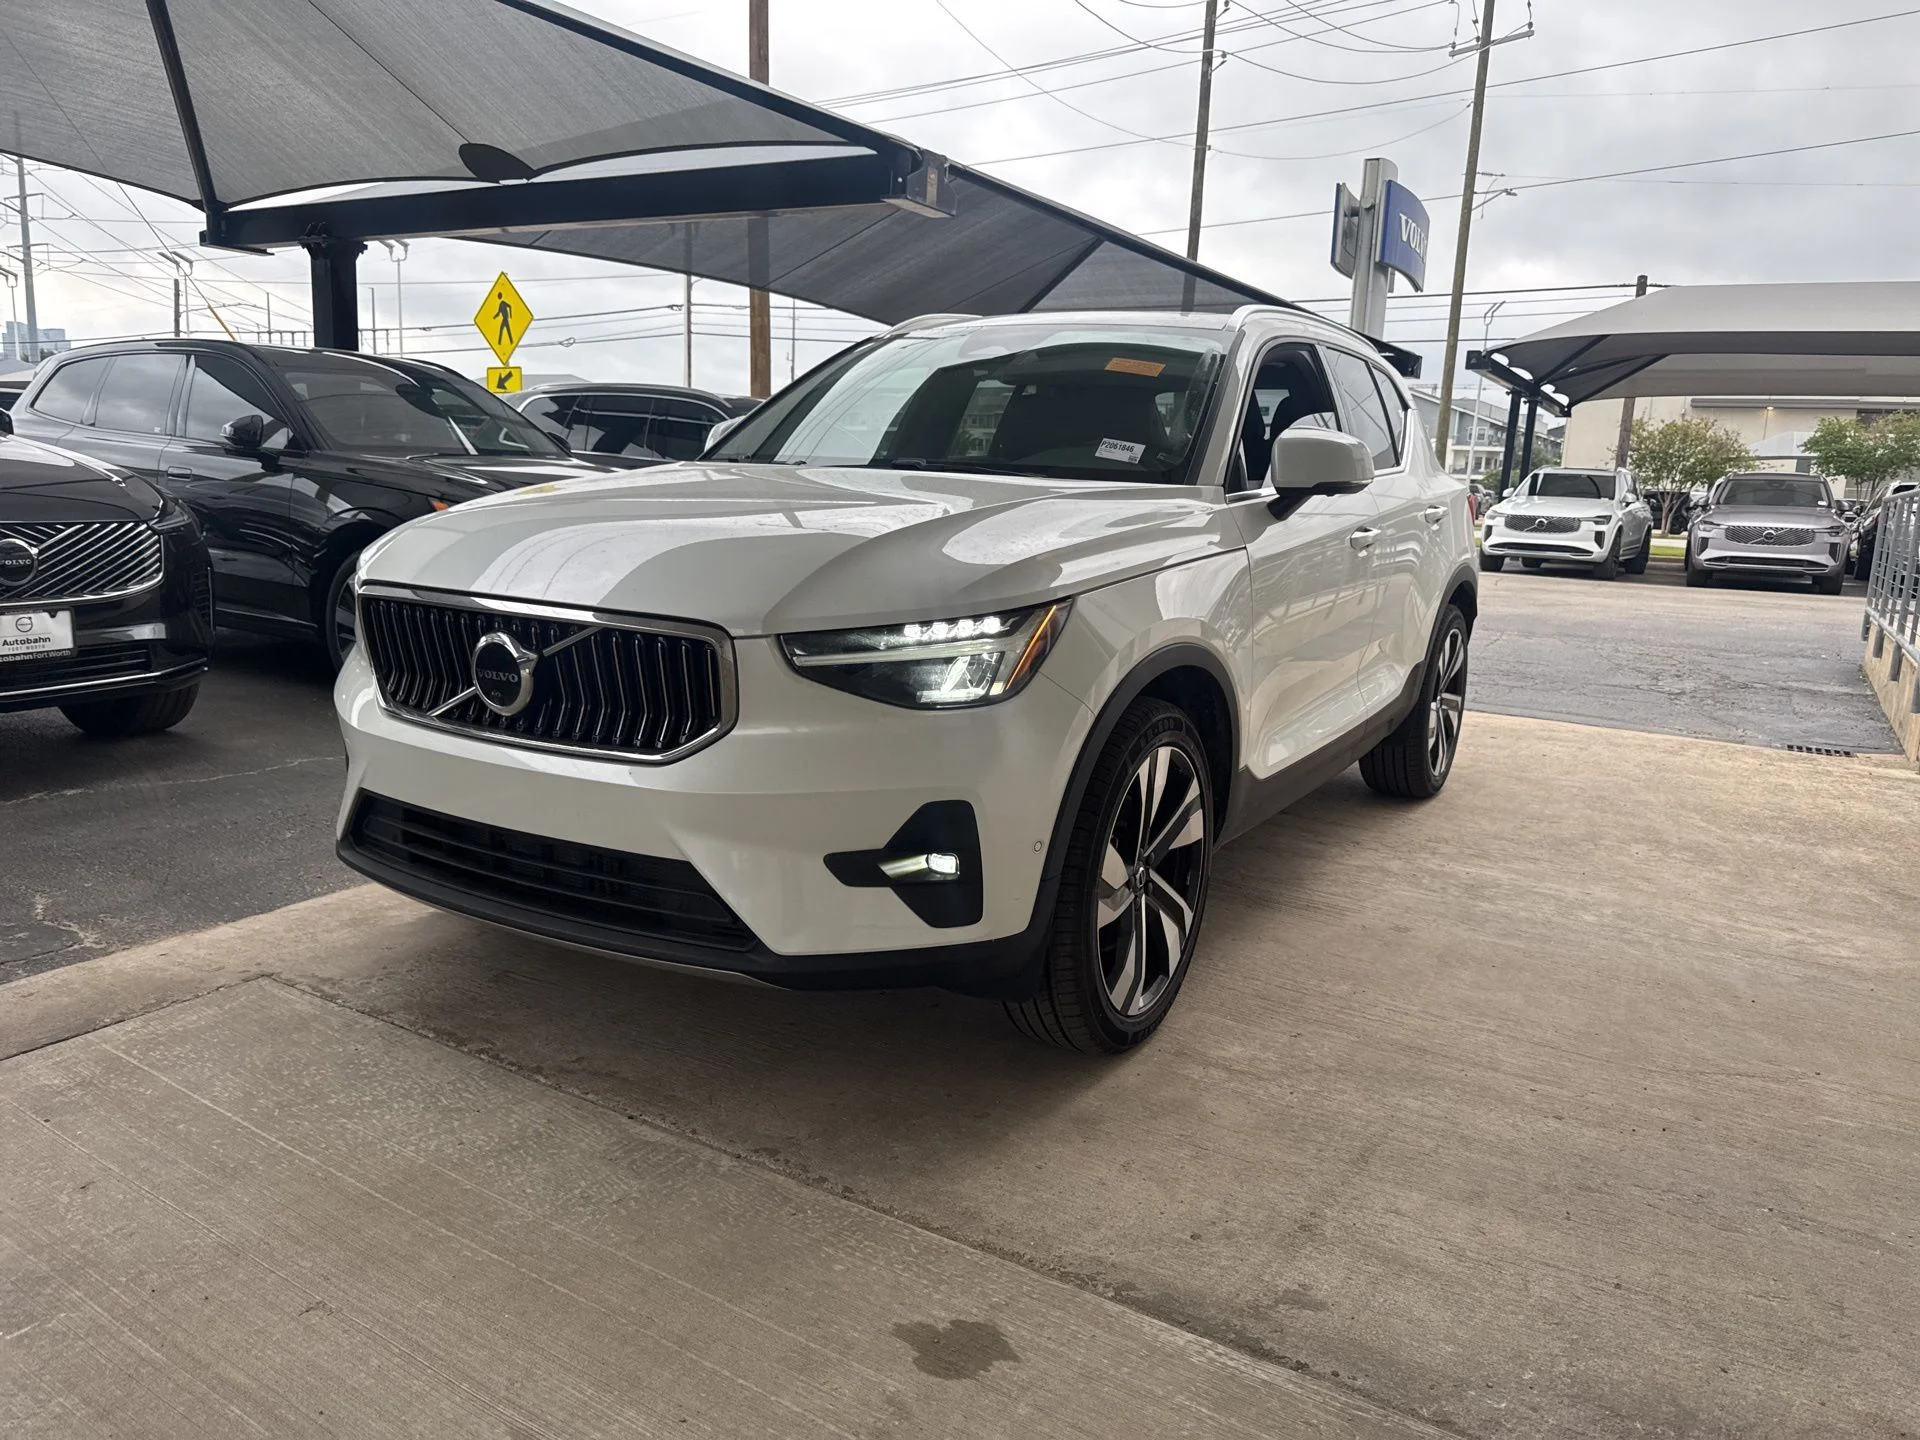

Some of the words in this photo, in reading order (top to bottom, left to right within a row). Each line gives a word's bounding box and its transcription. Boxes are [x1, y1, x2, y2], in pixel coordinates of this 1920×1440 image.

[1101, 440, 1135, 452] P2061846
[2, 636, 51, 647] Autobahn
[33, 651, 48, 659] Fort
[48, 649, 71, 657] Worth
[478, 669, 519, 683] VOLVO
